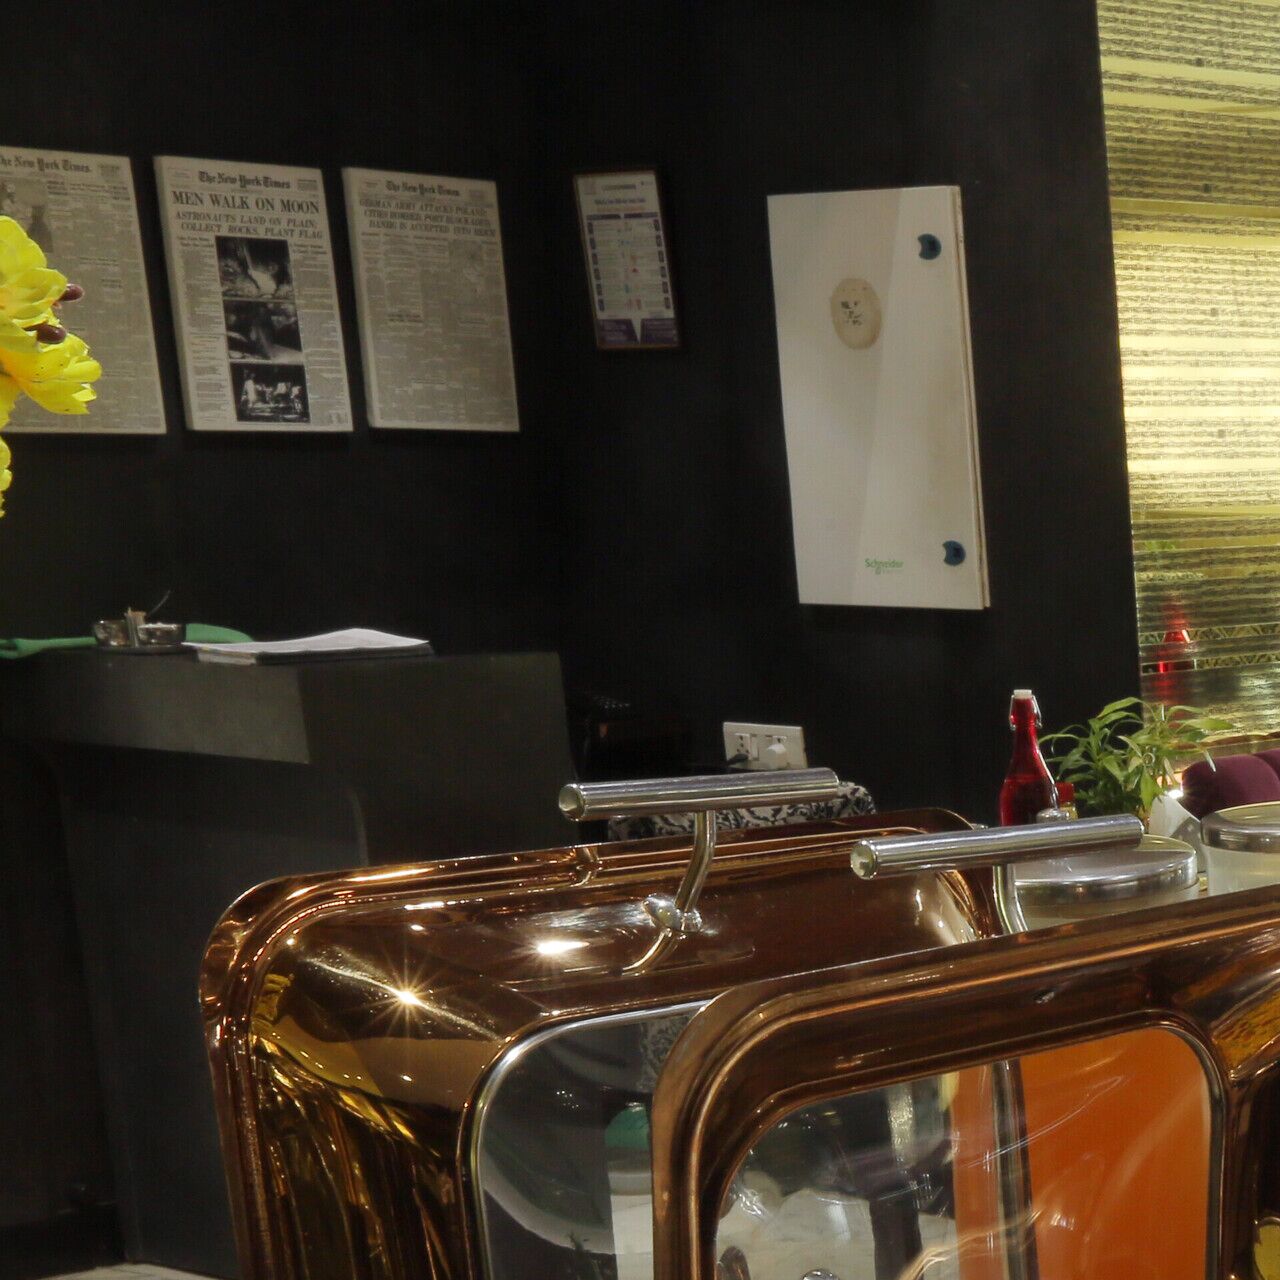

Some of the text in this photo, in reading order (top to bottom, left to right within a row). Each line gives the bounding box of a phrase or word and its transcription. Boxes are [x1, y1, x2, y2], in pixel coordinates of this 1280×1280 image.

[36, 157, 60, 172] York
[62, 159, 91, 172] Times
[198, 170, 216, 184] The
[217, 172, 236, 185] New
[238, 174, 262, 188] York
[263, 176, 291, 189] Times
[171, 190, 320, 214] MEN WALK ON MOON
[175, 211, 236, 223] ASTRONAUTS
[240, 214, 266, 226] LAND
[269, 216, 281, 226] ON
[181, 222, 222, 233] COLLECT
[265, 227, 294, 238] PLANT
[299, 229, 323, 239] FLAG
